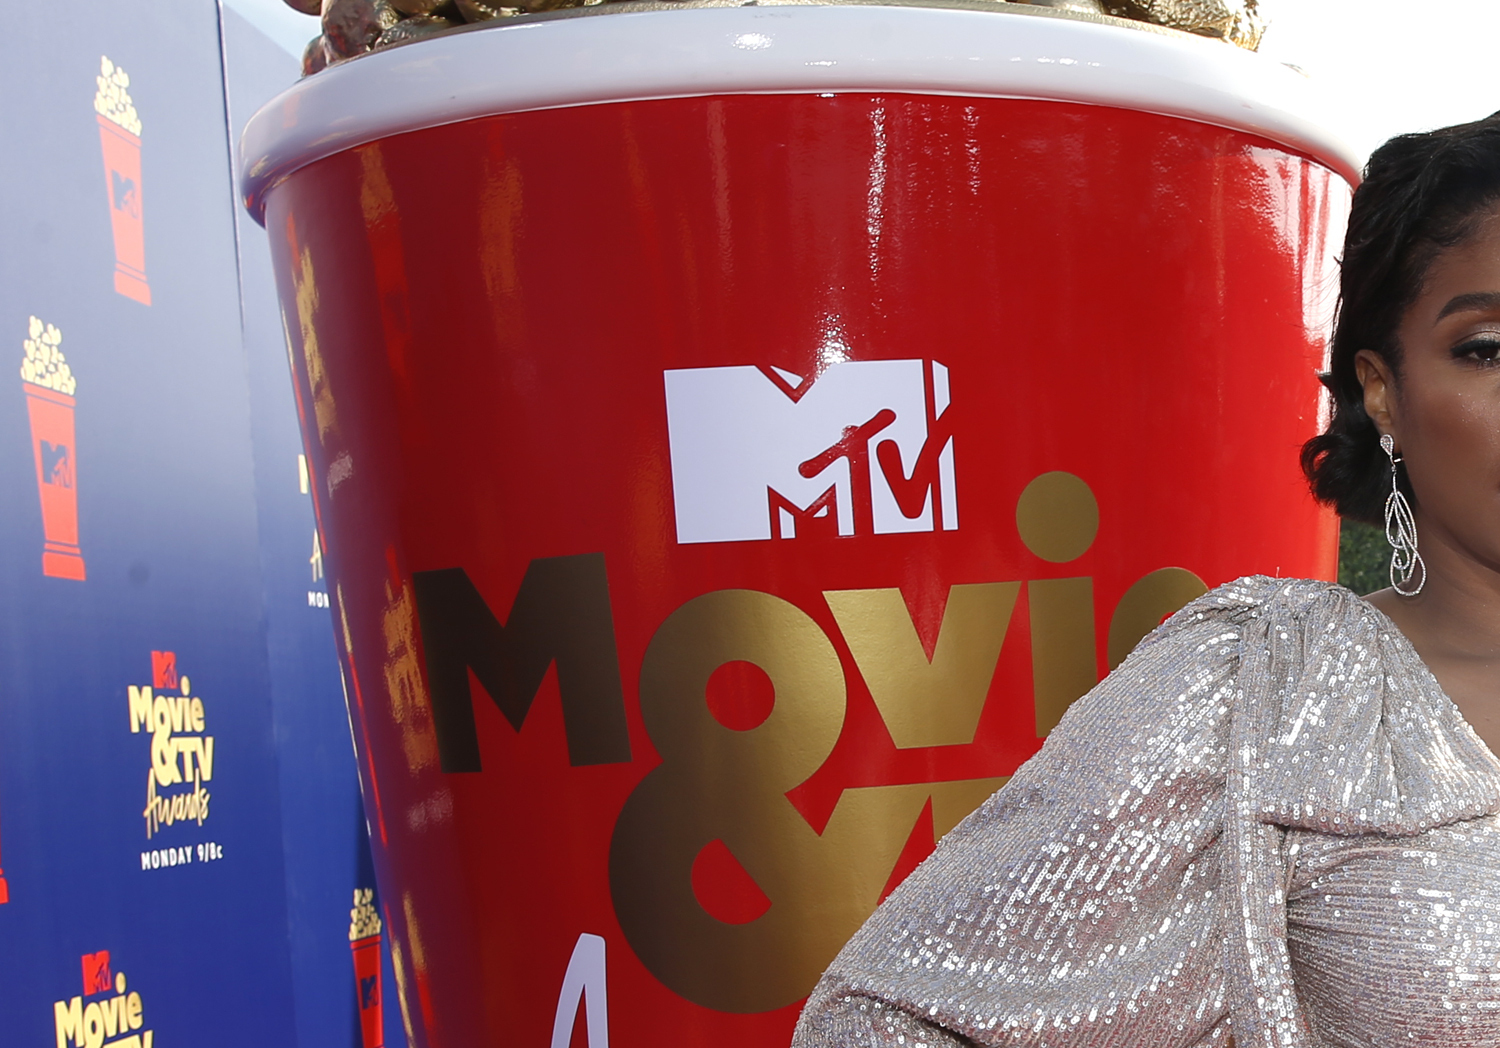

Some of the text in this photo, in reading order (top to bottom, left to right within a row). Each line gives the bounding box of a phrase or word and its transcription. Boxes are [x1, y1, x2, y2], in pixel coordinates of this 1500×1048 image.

[664, 359, 958, 544] MTV
[151, 650, 178, 689] MTV
[127, 675, 205, 734] Movie
[151, 695, 214, 787] &TV
[143, 767, 210, 840] Awards
[141, 842, 223, 871] MONDAY 9/8c
[81, 950, 112, 996] MTV
